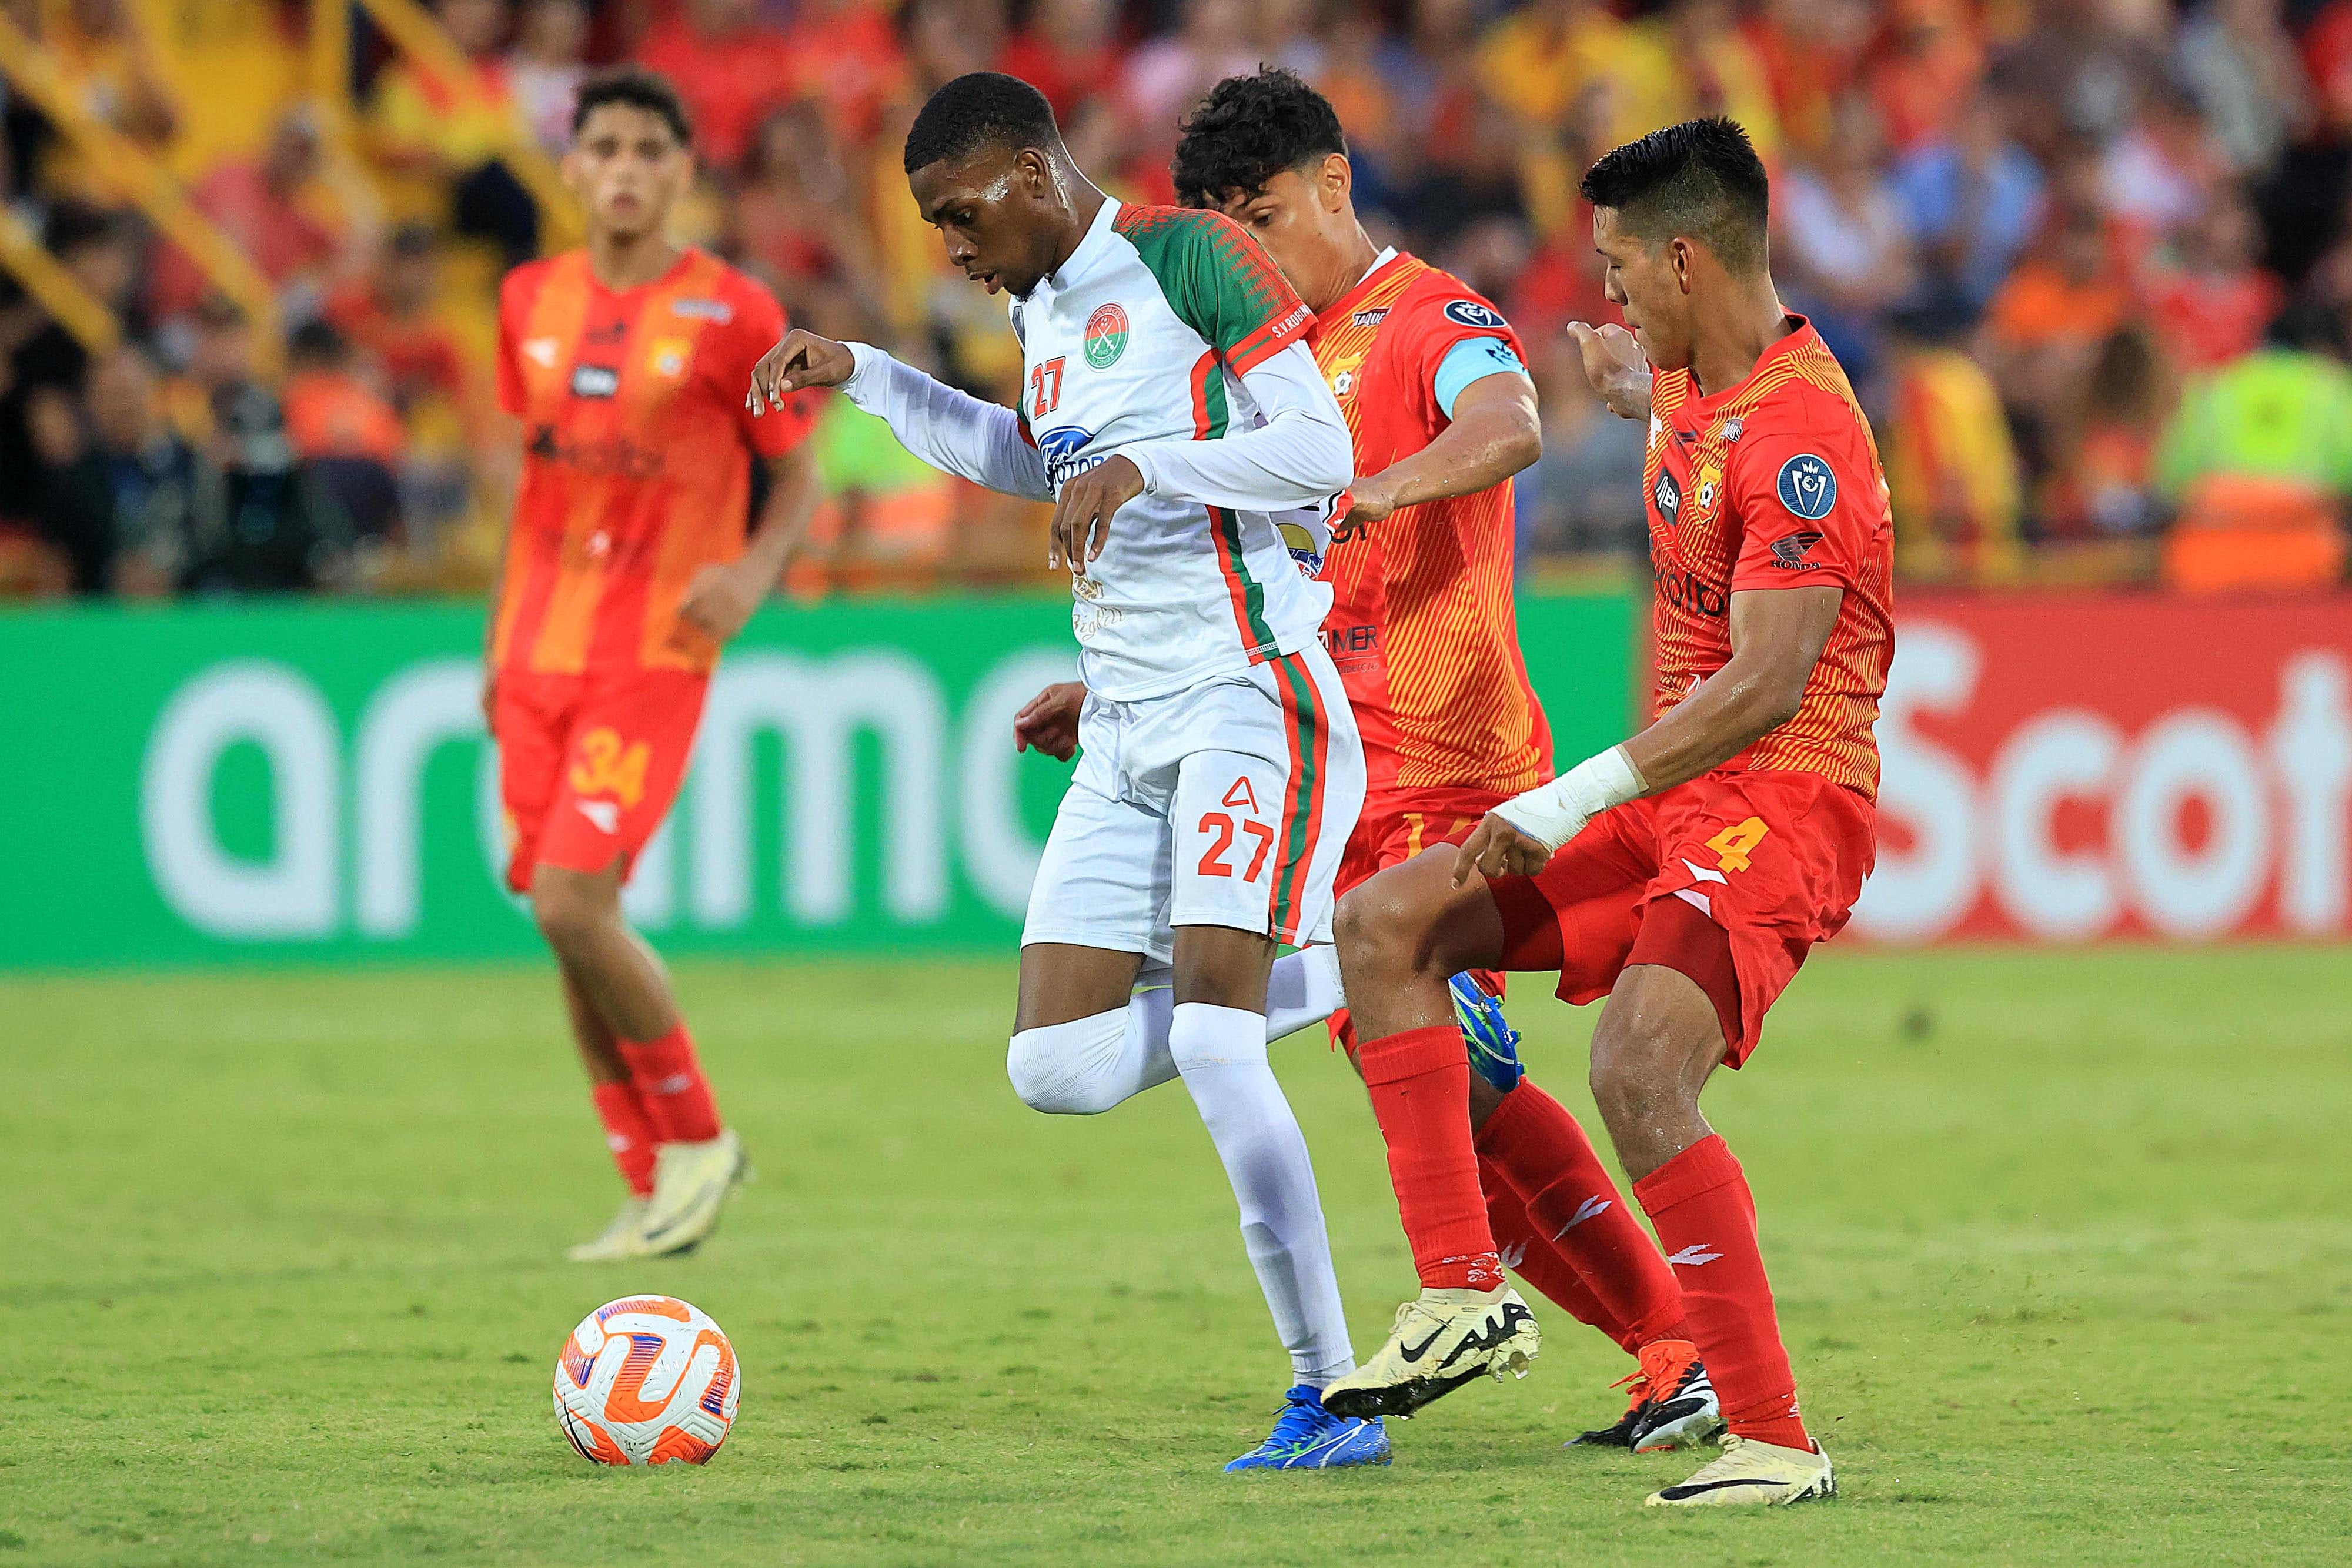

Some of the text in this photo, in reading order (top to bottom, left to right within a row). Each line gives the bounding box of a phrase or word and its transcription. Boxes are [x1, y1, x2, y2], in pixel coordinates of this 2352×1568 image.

[1031, 356, 1066, 420] 27
[569, 727, 650, 810] 34
[1198, 812, 1274, 883] 27
[1703, 816, 1770, 875] 4
